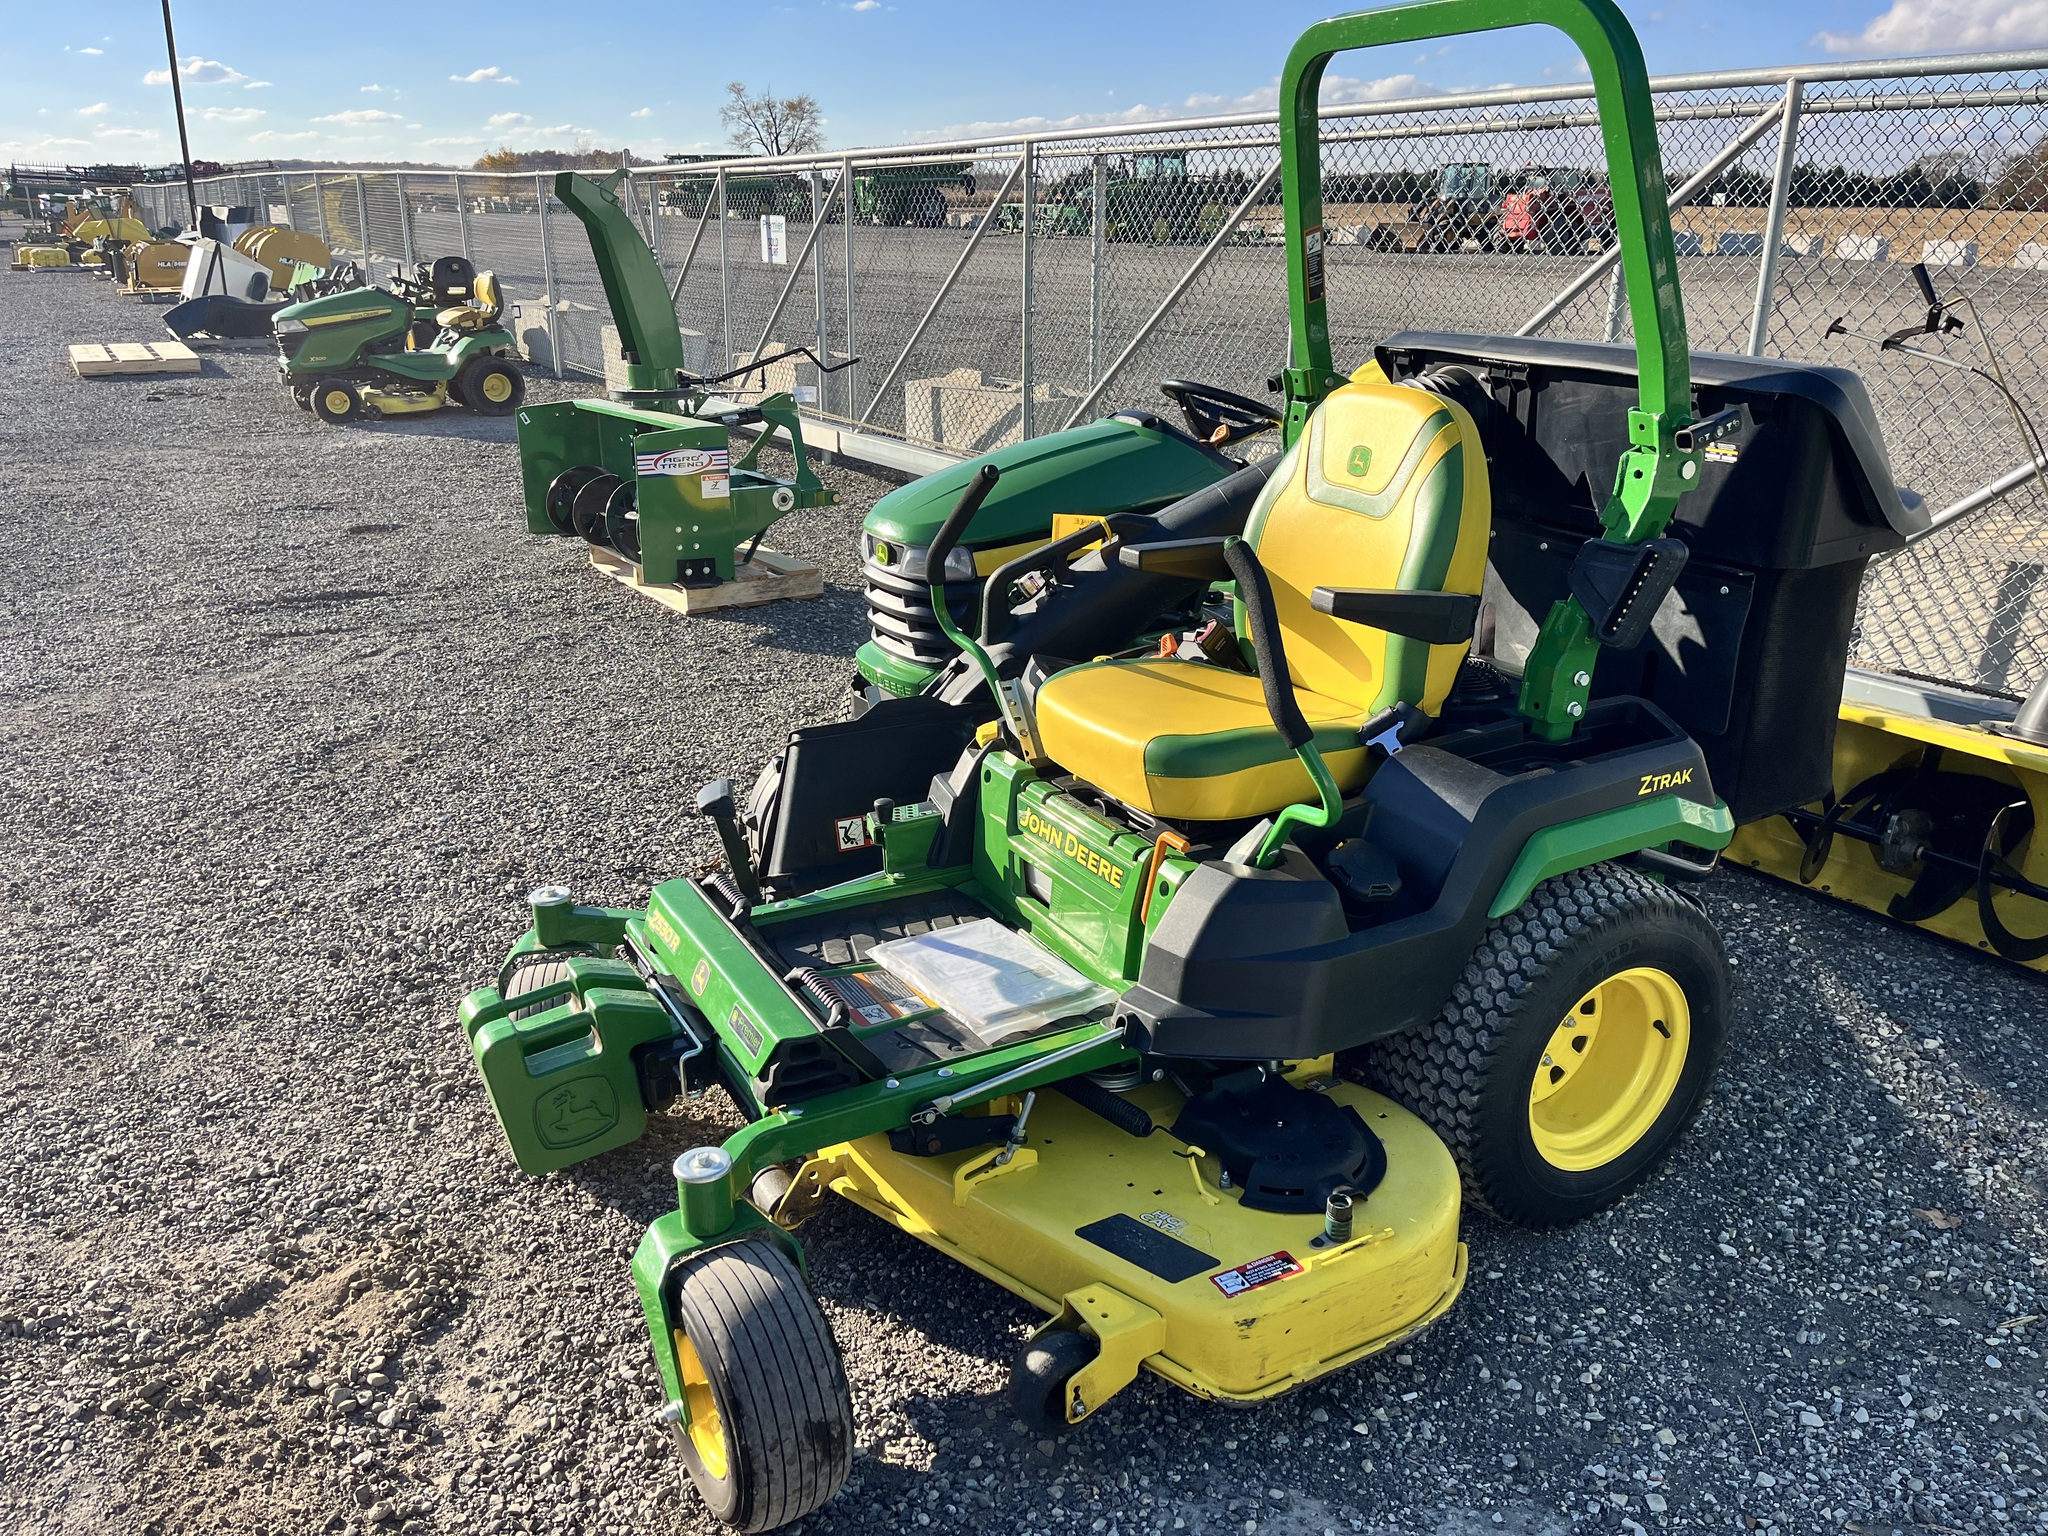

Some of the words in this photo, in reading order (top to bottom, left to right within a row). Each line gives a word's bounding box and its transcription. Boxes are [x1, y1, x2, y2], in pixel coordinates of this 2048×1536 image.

[660, 461, 704, 469] TREND
[662, 455, 700, 463] AGRO
[1637, 767, 1694, 796] ZTRAK
[1019, 806, 1063, 850] JOHN
[1064, 832, 1125, 890] DEERE
[737, 1016, 762, 1050] Premier
[1250, 1255, 1276, 1268] DANGER
